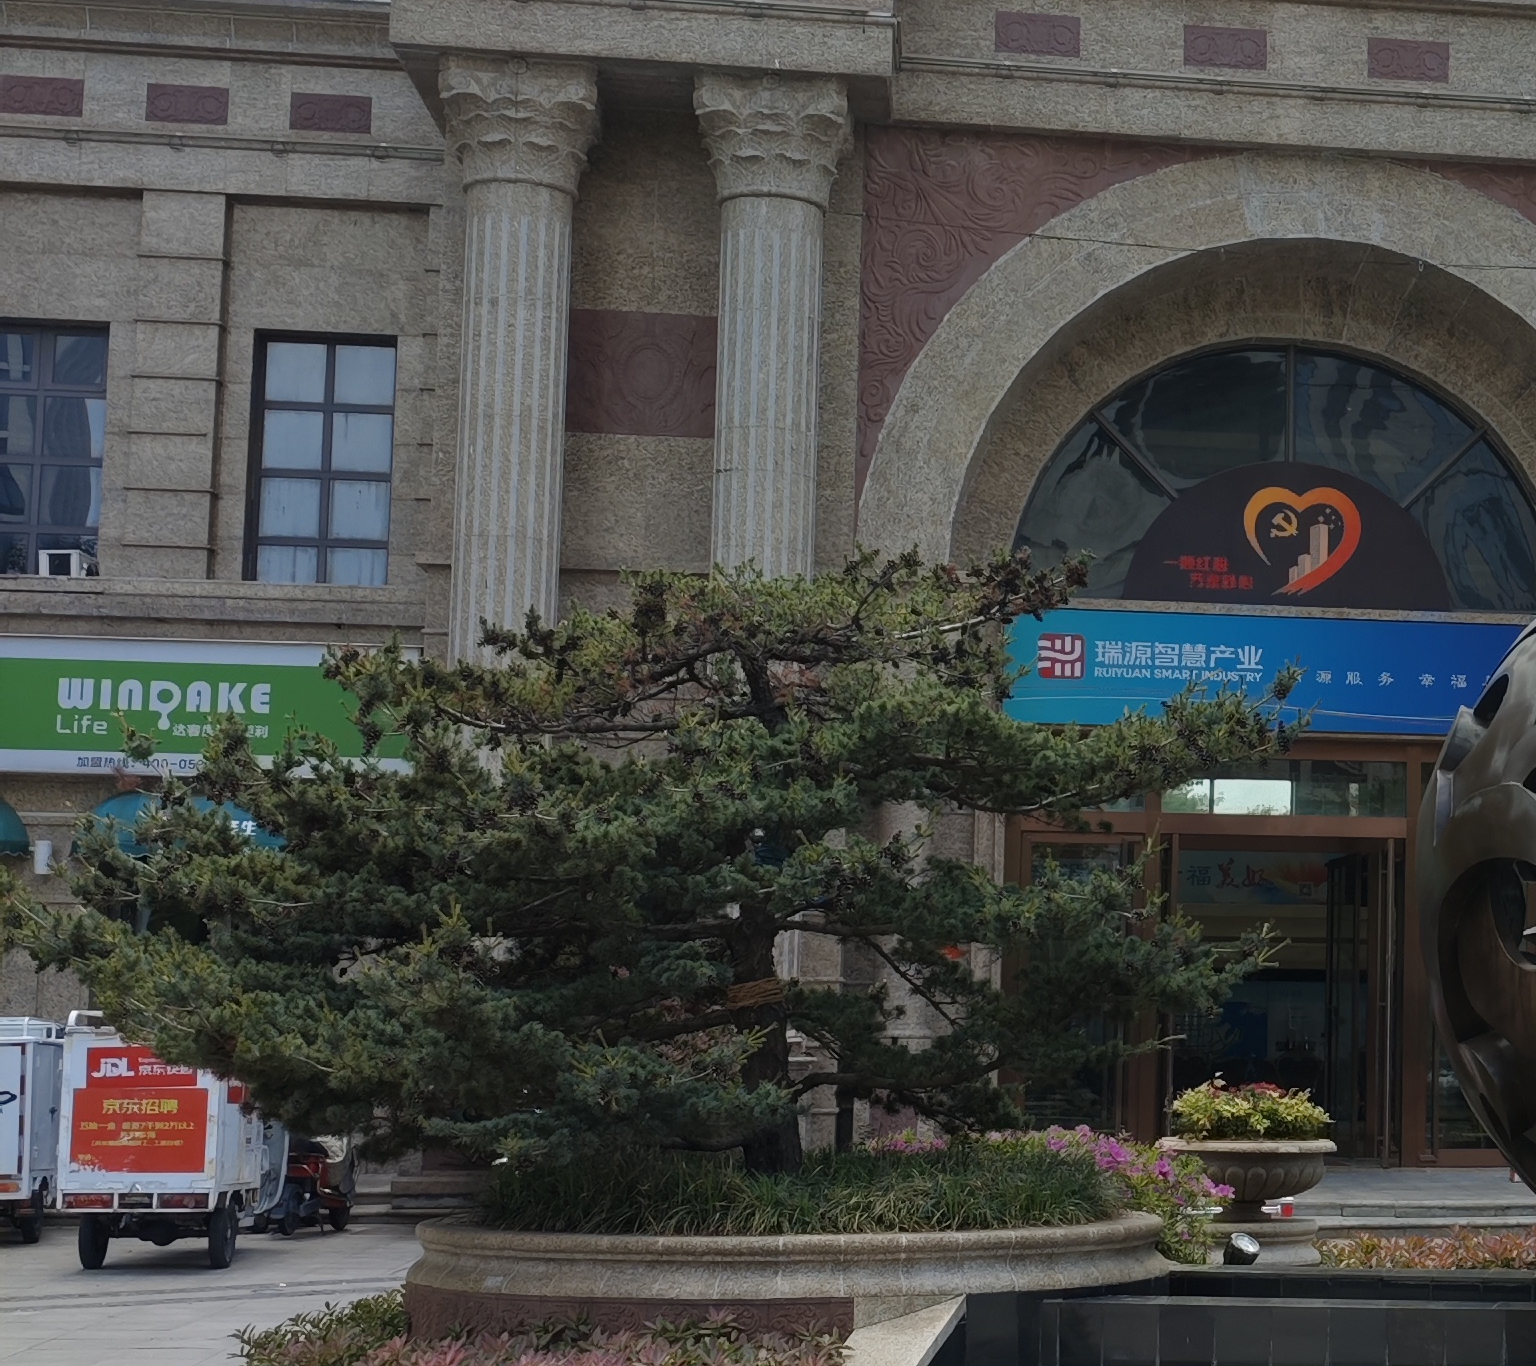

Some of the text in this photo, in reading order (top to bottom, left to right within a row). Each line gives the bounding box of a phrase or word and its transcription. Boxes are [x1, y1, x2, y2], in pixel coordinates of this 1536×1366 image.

[1094, 640, 1264, 670] 瑞源智慧产业
[1094, 667, 1264, 682] RUIYUAN SMART INDUSTRY
[1295, 670, 1490, 689] 源服务 幸福
[56, 714, 108, 736] Life
[1178, 857, 1268, 889] 福美好
[91, 1057, 135, 1078] JDL
[102, 1098, 179, 1115] 京东招聘
